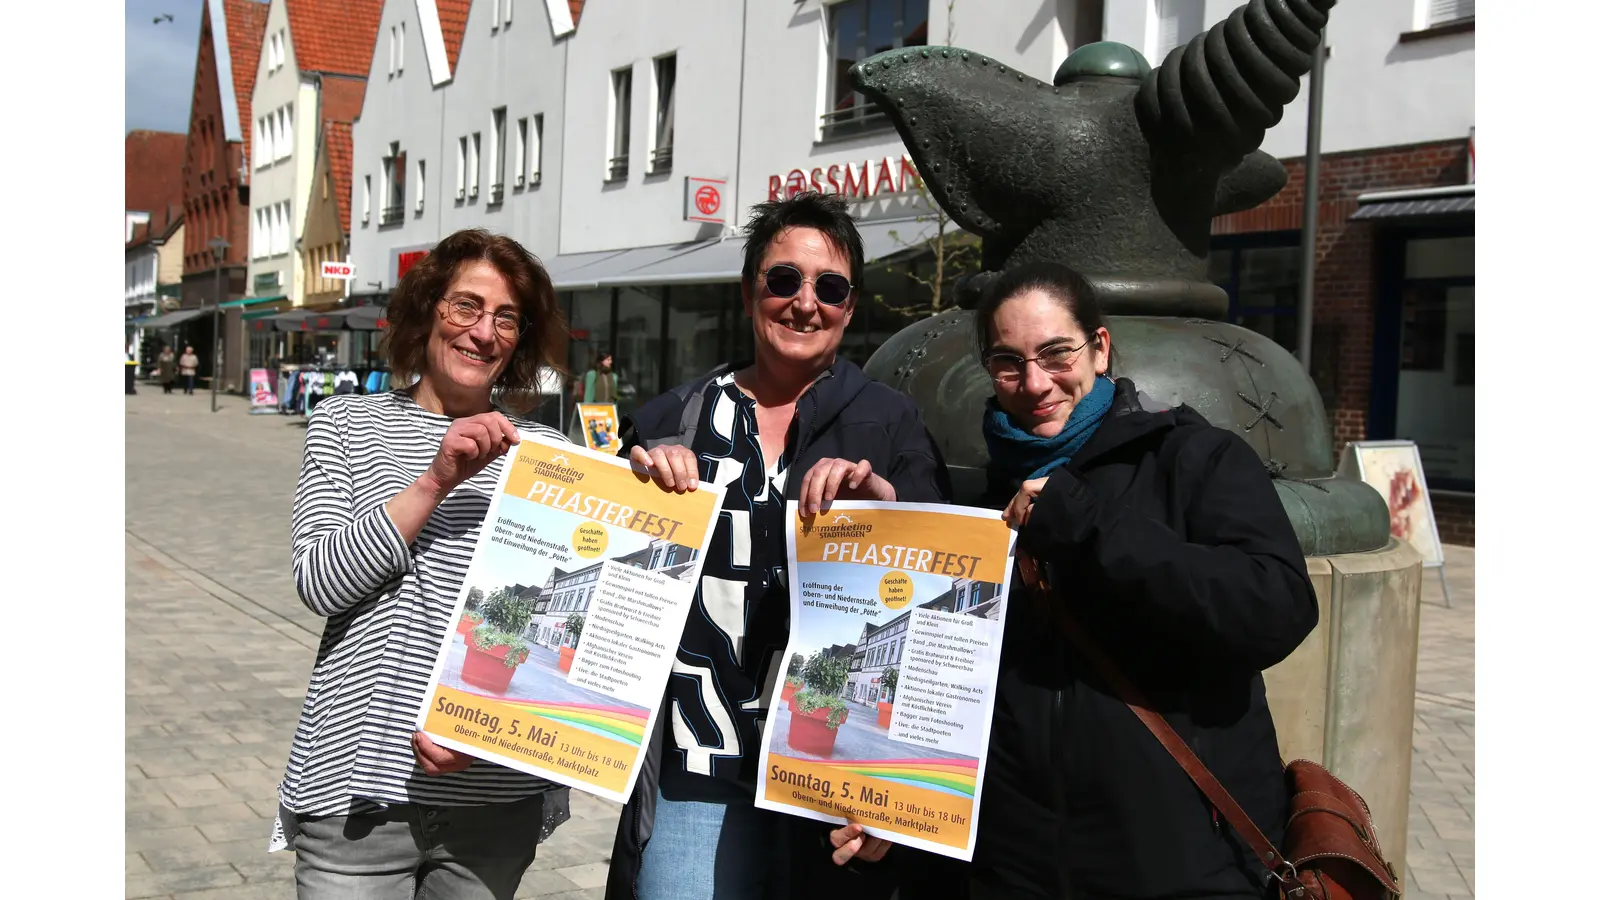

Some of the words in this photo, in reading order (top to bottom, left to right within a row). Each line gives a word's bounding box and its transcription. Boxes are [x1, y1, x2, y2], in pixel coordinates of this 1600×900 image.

[324, 266, 351, 276] NKD
[533, 468, 575, 484] STADTHAGEN
[527, 481, 683, 541] PFLASTERFEST
[497, 516, 526, 531] Eröffnung
[579, 527, 603, 536] Geschäfte
[492, 535, 502, 544] und
[503, 538, 537, 556] Einweihung
[539, 549, 548, 557] der
[494, 526, 514, 538] Obern-
[515, 532, 527, 541] und
[527, 534, 569, 553] Niedernstraße
[578, 545, 600, 553] geöffnet!
[822, 542, 982, 578] PFLASTERFEST
[803, 582, 832, 592] Eröffnung
[803, 592, 823, 600] Obern-
[824, 593, 836, 601] und
[837, 595, 877, 606] Niedernstraße
[885, 595, 907, 603] geöffnet!
[816, 601, 848, 614] Einweihung
[931, 615, 952, 623] Aktionen
[915, 630, 943, 639] Gewinnspiel
[954, 635, 969, 643] tollen
[910, 656, 934, 665] sponsored
[943, 662, 973, 672] Schweerbau
[925, 651, 949, 660] Bratwurst
[955, 656, 974, 664] Freibier
[908, 665, 938, 675] Modenschau
[904, 685, 926, 693] Aktionen
[927, 688, 944, 697] lokaler
[946, 693, 980, 703] Gastronomen
[950, 683, 971, 693] Walking
[903, 694, 935, 705] Afghanischer
[936, 700, 952, 708] Verein
[911, 703, 946, 715] Köstlichkeiten
[900, 711, 918, 720] Bagger
[931, 716, 964, 729] Fotoshooting
[435, 696, 503, 735] Sonntag,
[507, 719, 521, 737] 5.
[527, 725, 558, 748] Mai
[560, 743, 569, 752] 13
[571, 745, 585, 759] Uhr
[587, 750, 600, 762] bis
[601, 756, 612, 766] 18
[614, 759, 628, 771] Uhr
[920, 726, 951, 736] Stadtpoeten
[910, 733, 924, 741] vieles
[925, 736, 939, 744] mehr
[454, 724, 480, 740] Obern-
[482, 734, 497, 746] und
[499, 739, 553, 765] Niedernstraße,
[556, 756, 600, 778] Marktplatz
[771, 765, 835, 798] Sonntag,
[841, 782, 854, 799] 5.
[860, 786, 889, 807] Mai
[894, 801, 903, 811] 13
[906, 804, 921, 815] Uhr
[923, 808, 935, 818] bis
[938, 811, 948, 821] 18
[951, 813, 966, 825] Uhr
[792, 791, 816, 803] Obern-
[818, 799, 832, 808] und
[834, 802, 892, 824] Niedernstraße,
[895, 817, 939, 834] Marktplatz
